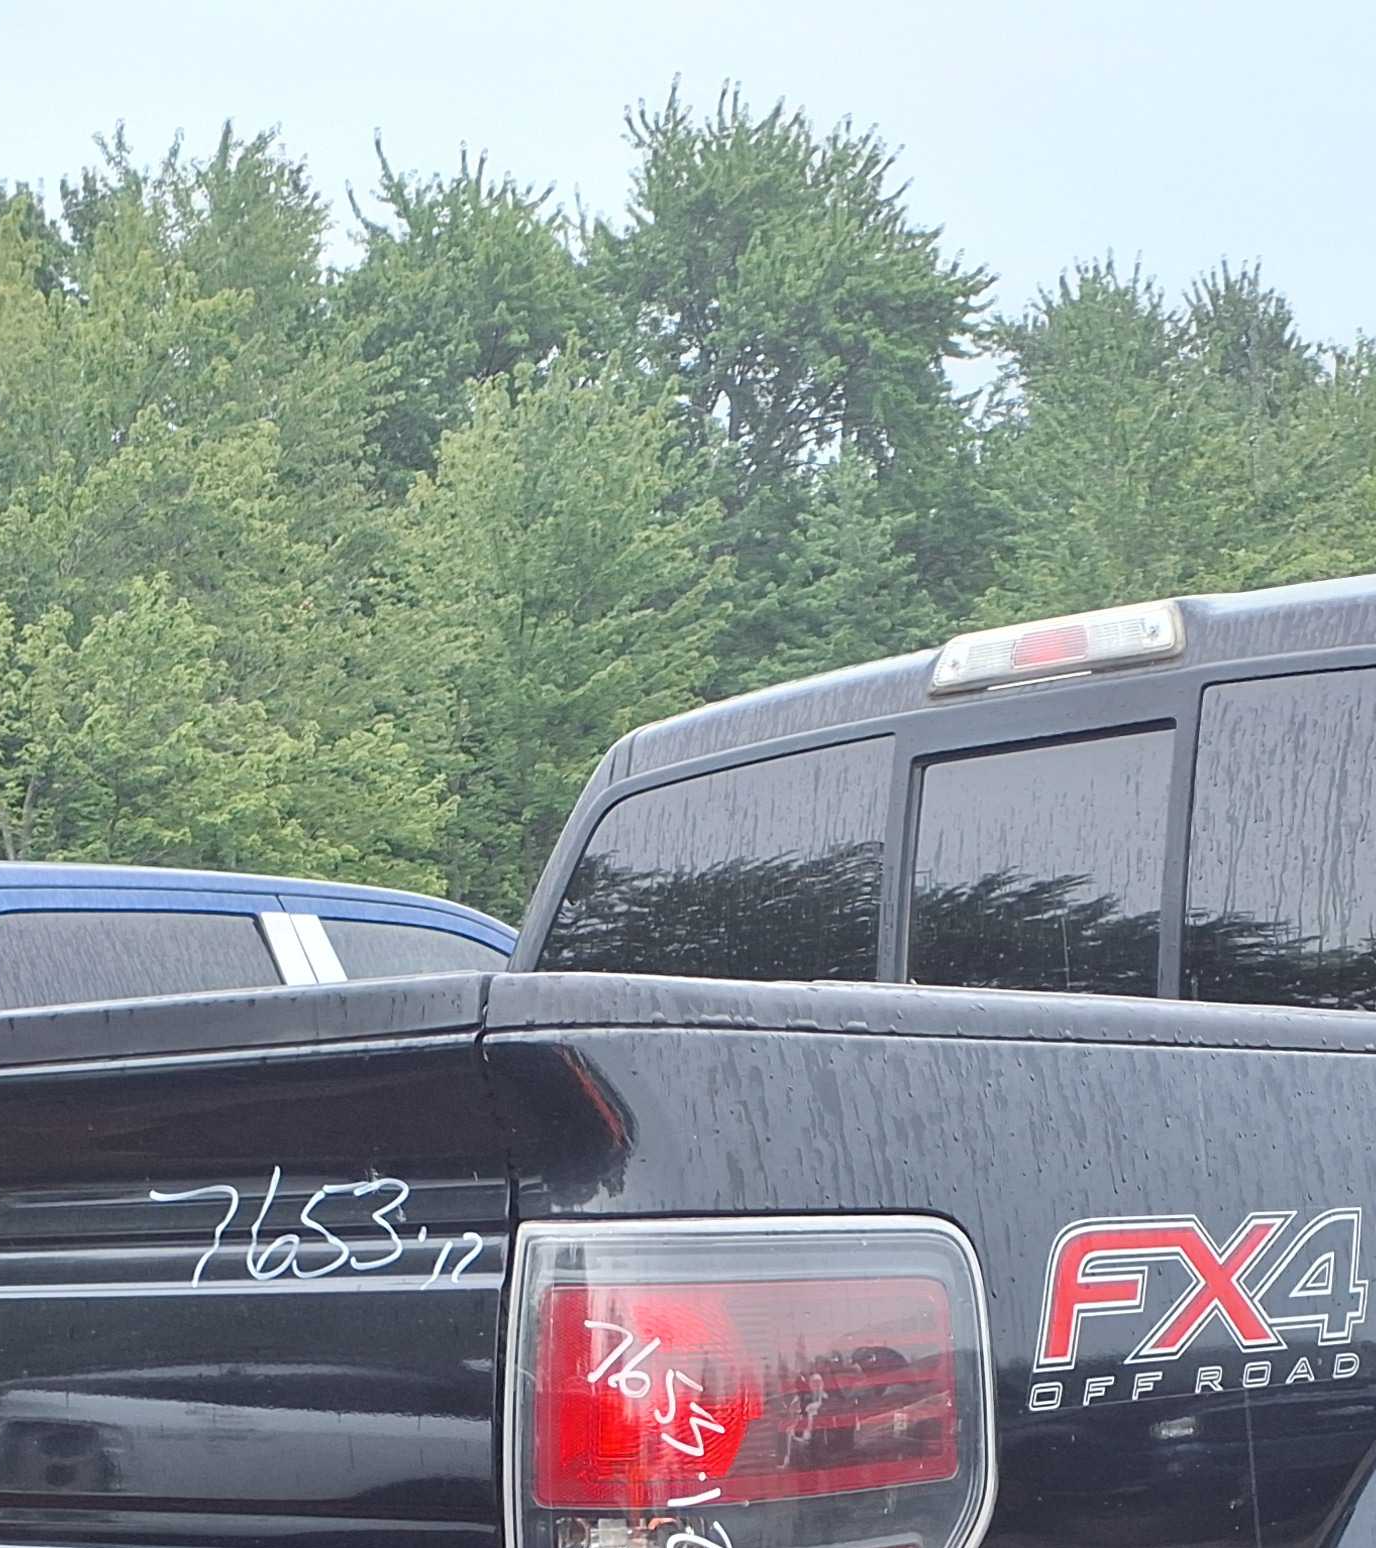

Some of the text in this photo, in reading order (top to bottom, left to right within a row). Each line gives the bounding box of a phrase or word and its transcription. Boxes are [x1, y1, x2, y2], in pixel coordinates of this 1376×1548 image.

[1033, 1207, 1369, 1373] FX4
[1029, 1353, 1361, 1411] OFF ROAD
